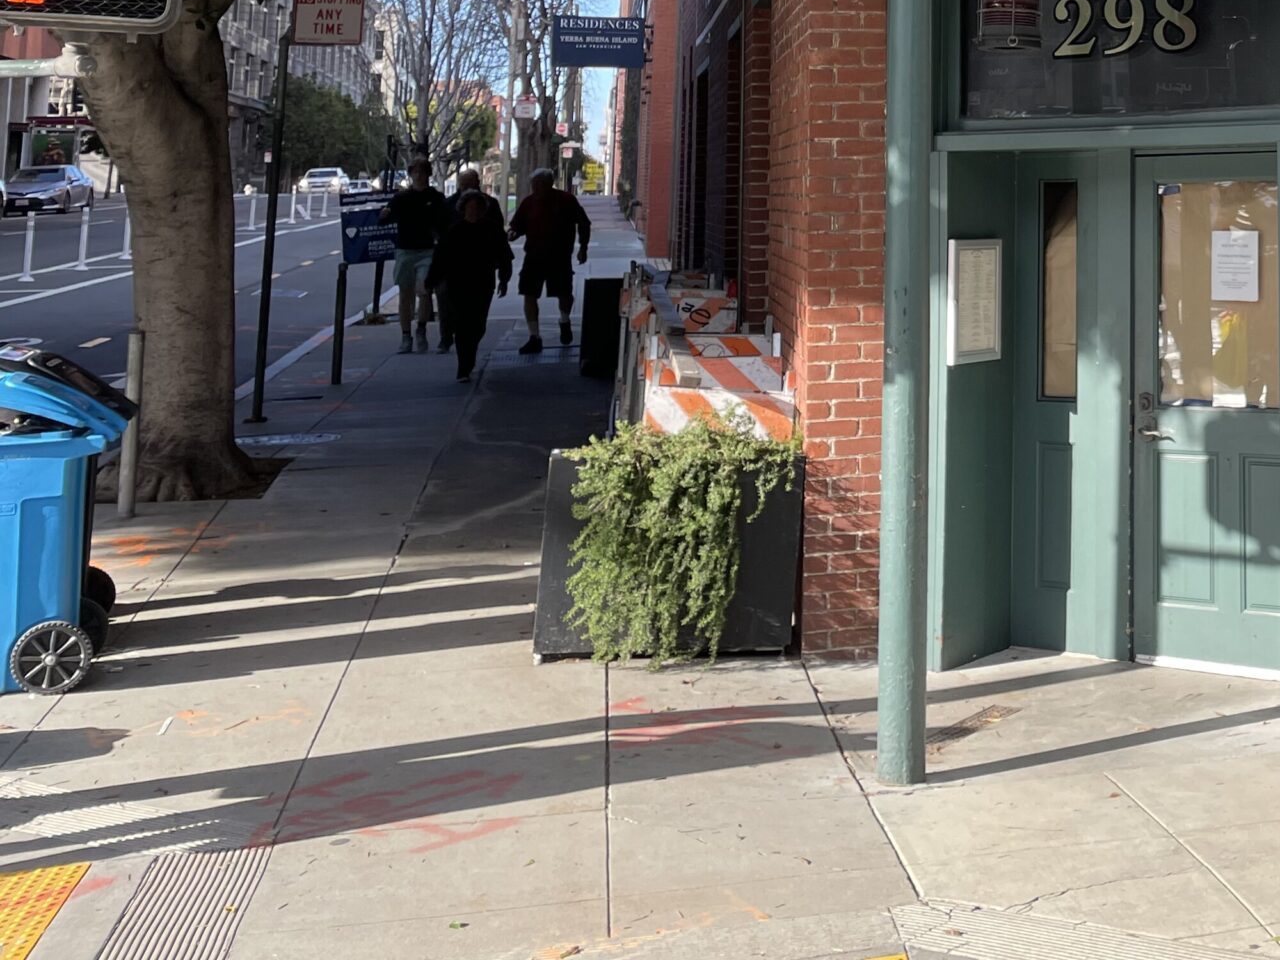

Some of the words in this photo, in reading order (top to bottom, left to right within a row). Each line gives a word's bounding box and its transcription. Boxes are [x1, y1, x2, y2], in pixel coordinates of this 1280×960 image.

[316, 9, 343, 20] ANY
[313, 22, 344, 35] TIME
[560, 18, 640, 30] RESIDENCES
